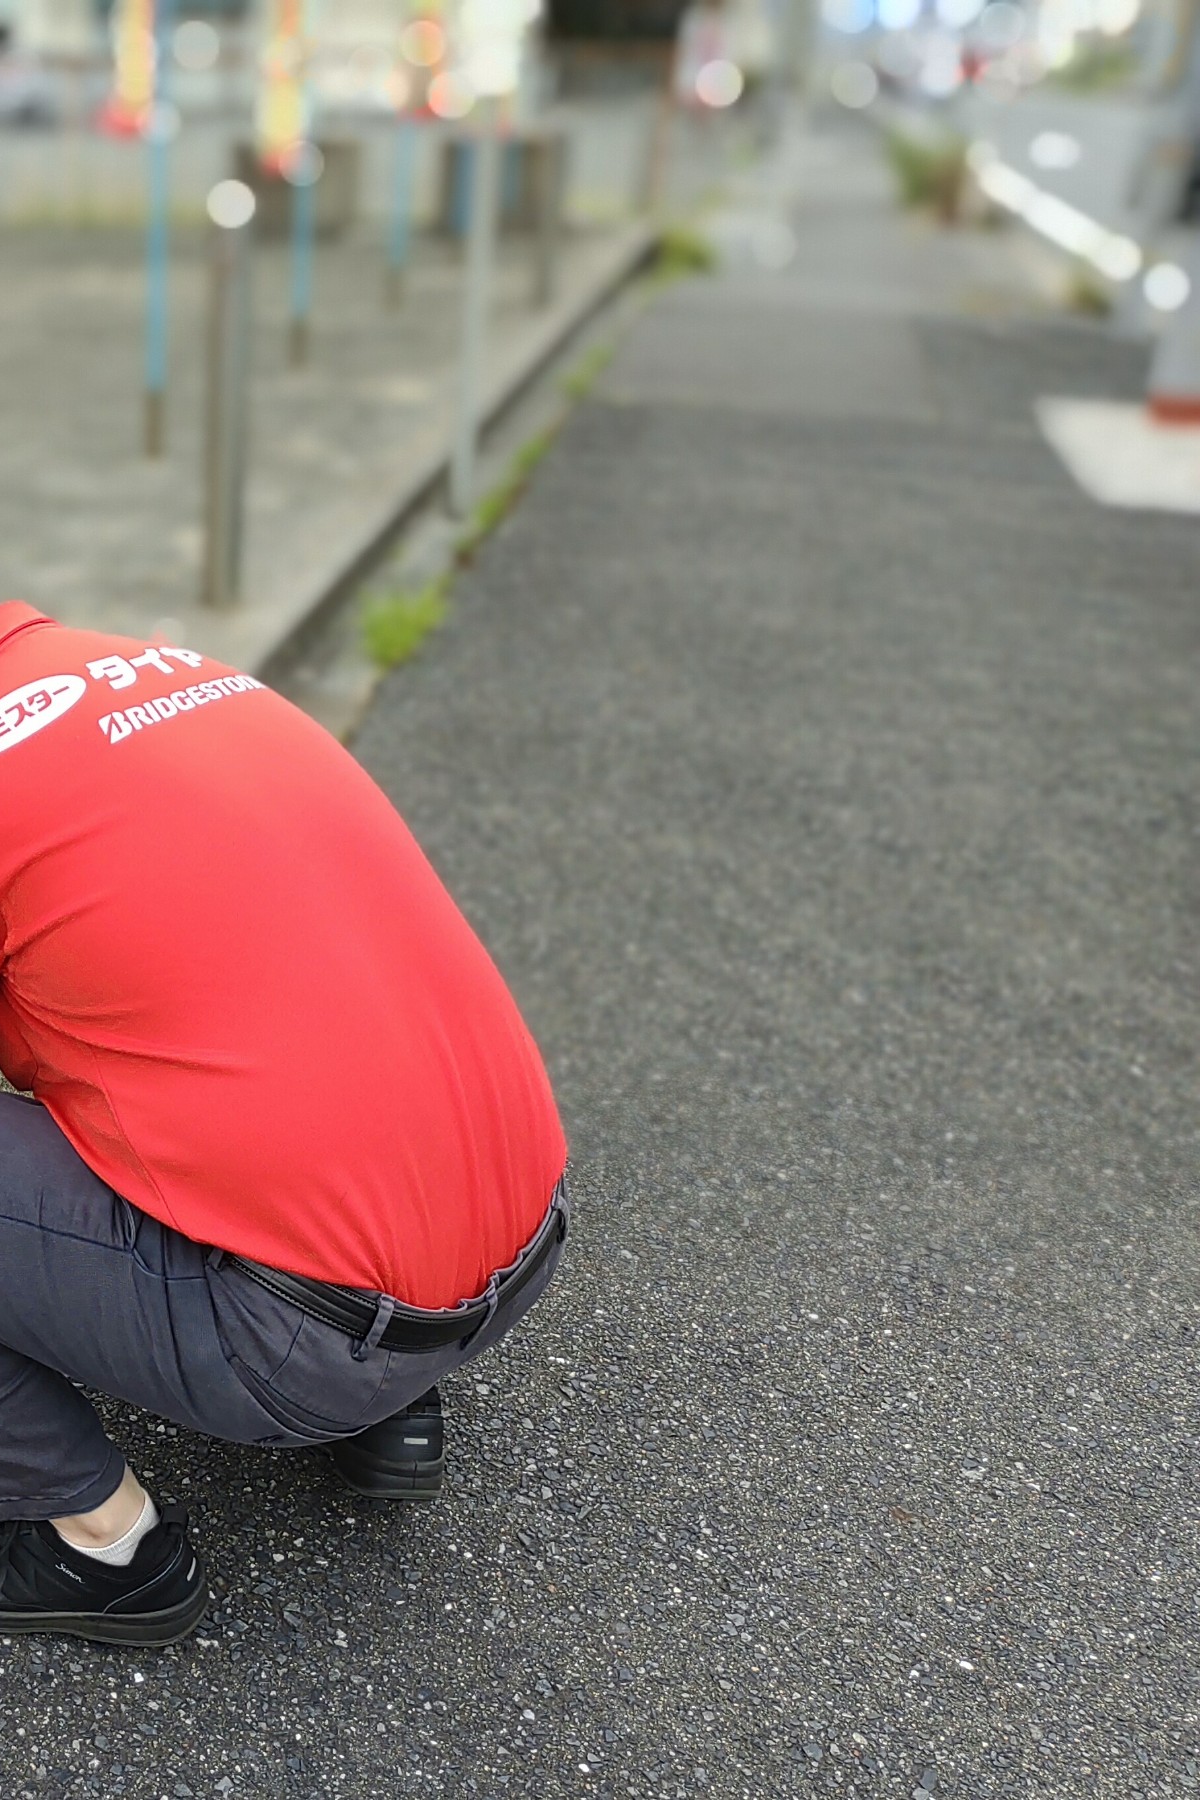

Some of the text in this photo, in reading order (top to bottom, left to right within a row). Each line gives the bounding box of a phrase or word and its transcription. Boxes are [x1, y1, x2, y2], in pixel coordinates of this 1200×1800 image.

[85, 647, 204, 690] タイヤ
[98, 674, 268, 744] BRIDGESTON
[55, 1563, 86, 1584] Simon
